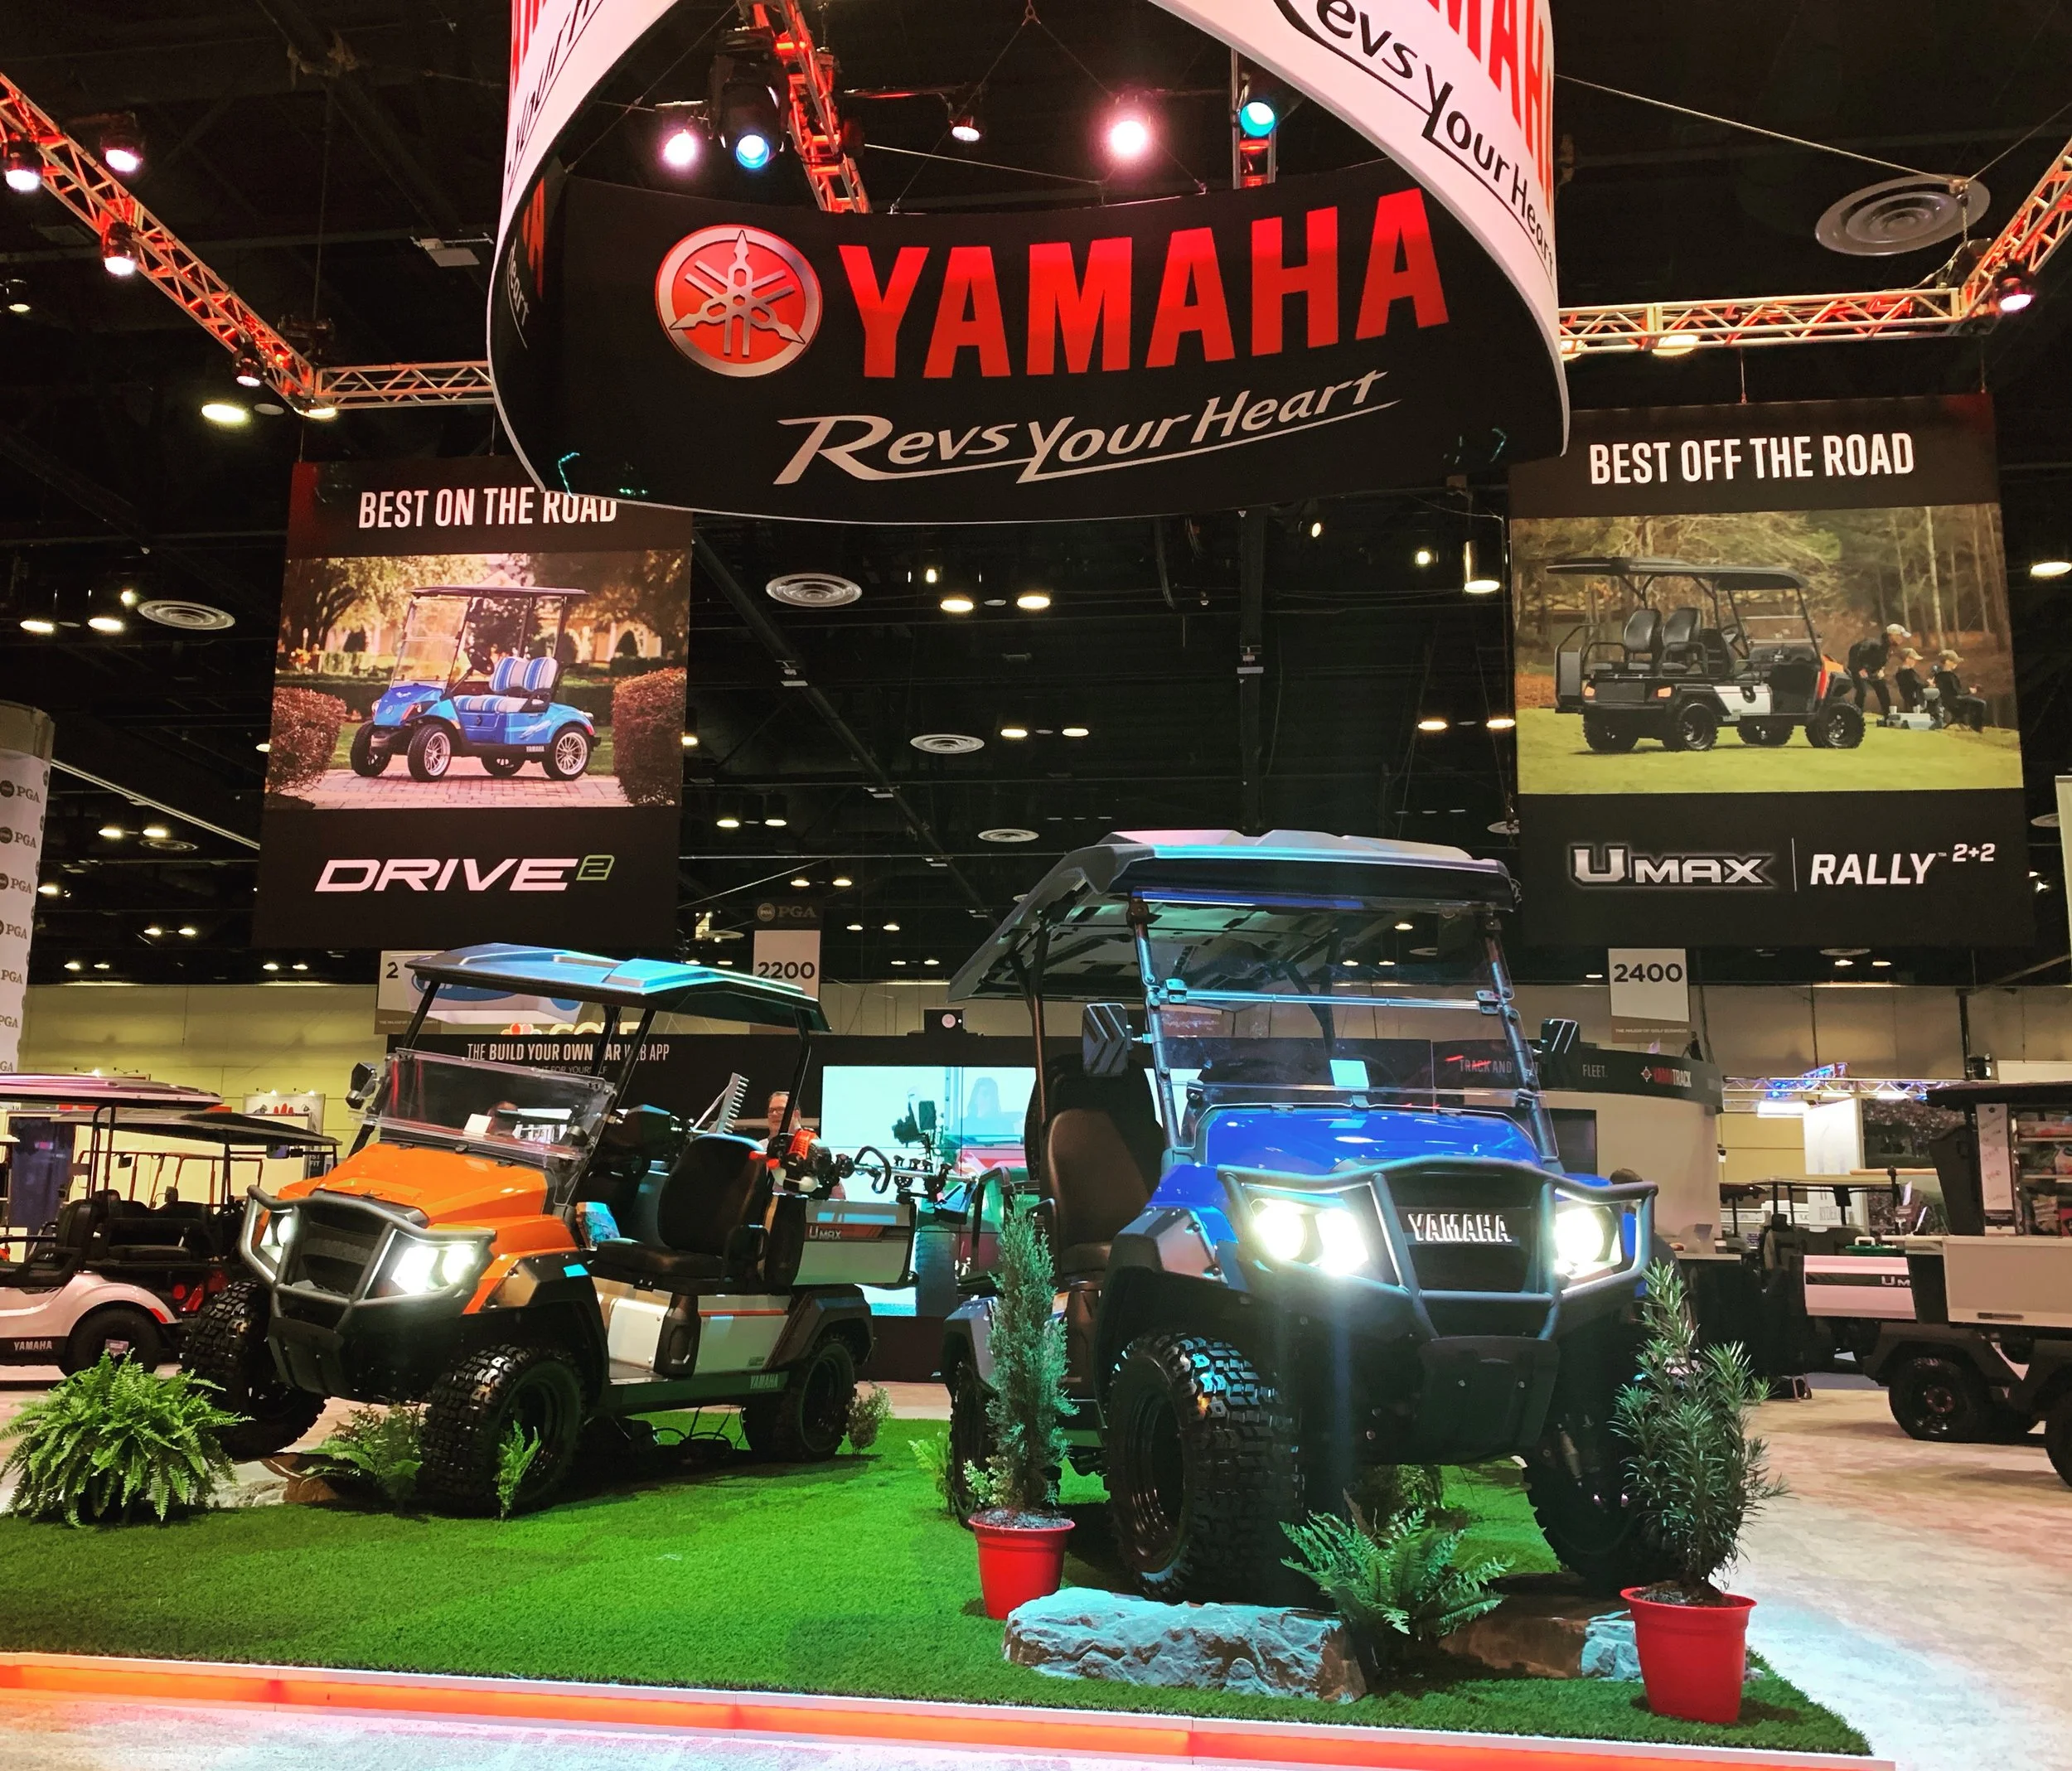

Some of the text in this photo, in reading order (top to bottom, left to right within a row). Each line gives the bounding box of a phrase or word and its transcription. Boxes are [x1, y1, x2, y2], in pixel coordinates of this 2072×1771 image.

[1421, 64, 1510, 183] Your
[1511, 162, 1554, 277] Heart
[838, 187, 1450, 379] YAMAHA
[773, 370, 1389, 485] Revs Your Heart
[1590, 433, 1915, 485] BEST OFF THE ROAD
[358, 486, 617, 529] BEST ON THE ROAD
[17, 785, 41, 803] PGA
[14, 831, 37, 849] PGA
[1952, 843, 1996, 863] 2+2
[10, 877, 32, 895] PGA
[777, 905, 817, 918] PGA
[6, 923, 27, 940] PGA
[1, 969, 23, 985] PGA
[758, 961, 816, 980] 2200
[1614, 963, 1683, 983] 2400
[467, 1043, 486, 1061] THE
[489, 1043, 525, 1061] BUILD
[527, 1043, 560, 1061] YOUR
[563, 1043, 593, 1061] OWN
[603, 1043, 621, 1061] AR
[649, 1043, 670, 1061] APP
[0, 1060, 14, 1072] GA
[1492, 1060, 1513, 1074] AND
[1407, 1213, 1513, 1242] YAMAHA
[1881, 1275, 1911, 1286] UM
[13, 1340, 53, 1352] YAMAHA
